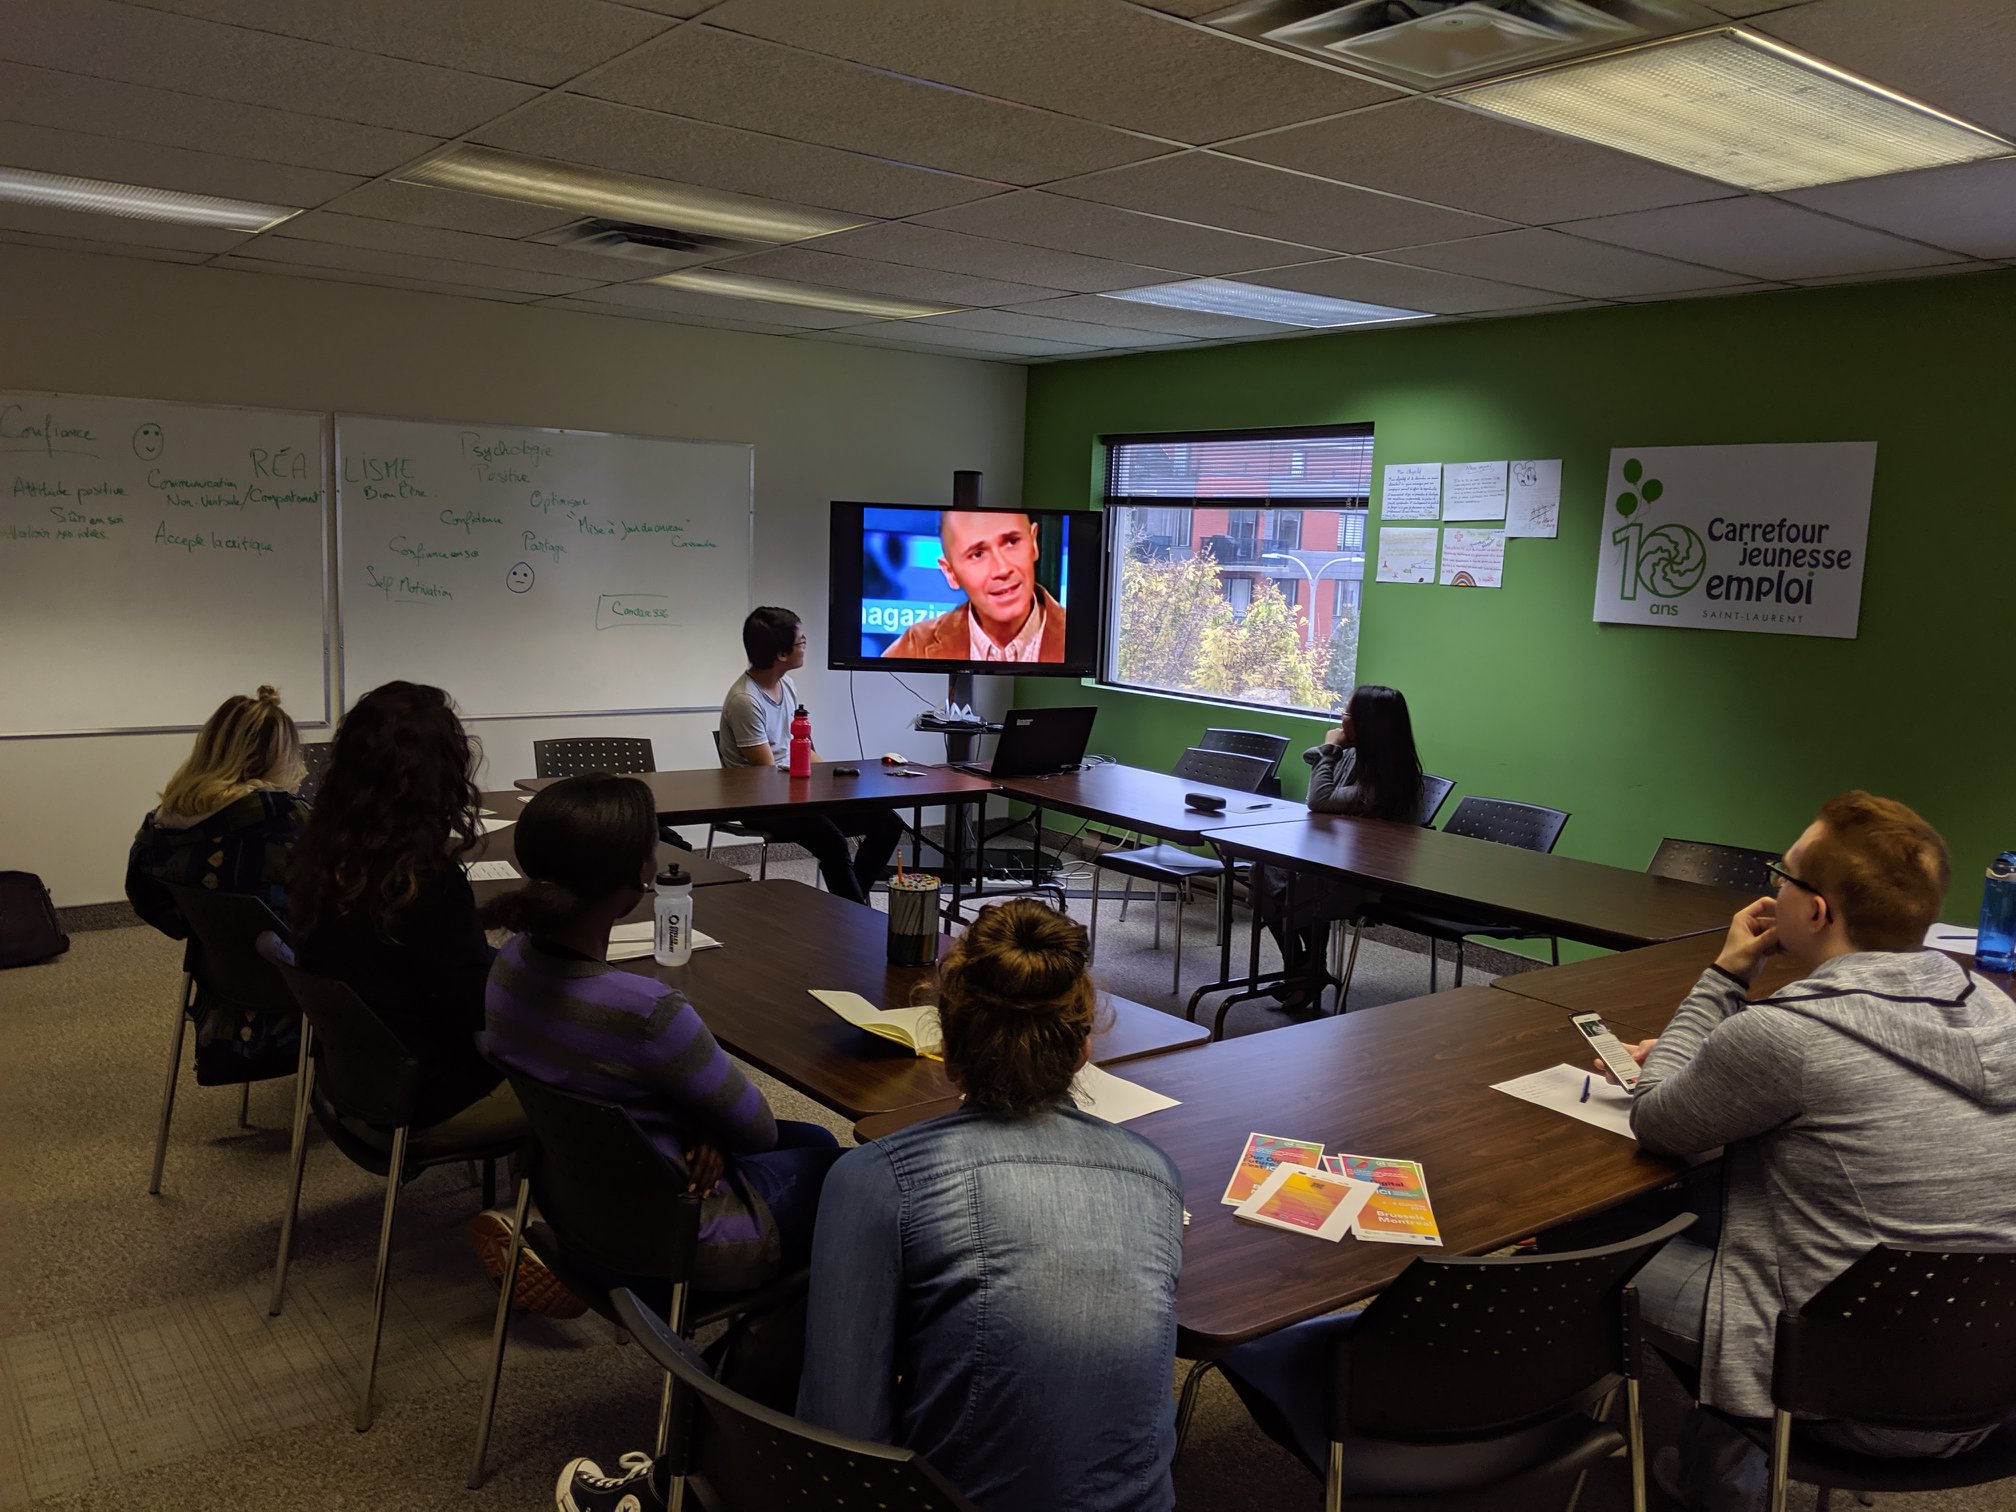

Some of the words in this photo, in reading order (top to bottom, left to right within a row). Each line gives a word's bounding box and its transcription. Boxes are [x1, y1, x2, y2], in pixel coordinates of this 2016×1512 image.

[458, 430, 553, 467] Psychologie
[13, 476, 73, 498] Attitude
[77, 480, 129, 506] positive
[1707, 516, 1830, 543] Carrefour
[521, 528, 568, 565] Partage
[1739, 541, 1852, 569] jeunesse
[399, 576, 454, 602] Motivation
[1705, 570, 1815, 605] emploi
[1649, 602, 1679, 616] ans
[1702, 609, 1804, 624] SAINT-LAURENT
[1376, 1209, 1426, 1221] Brussels
